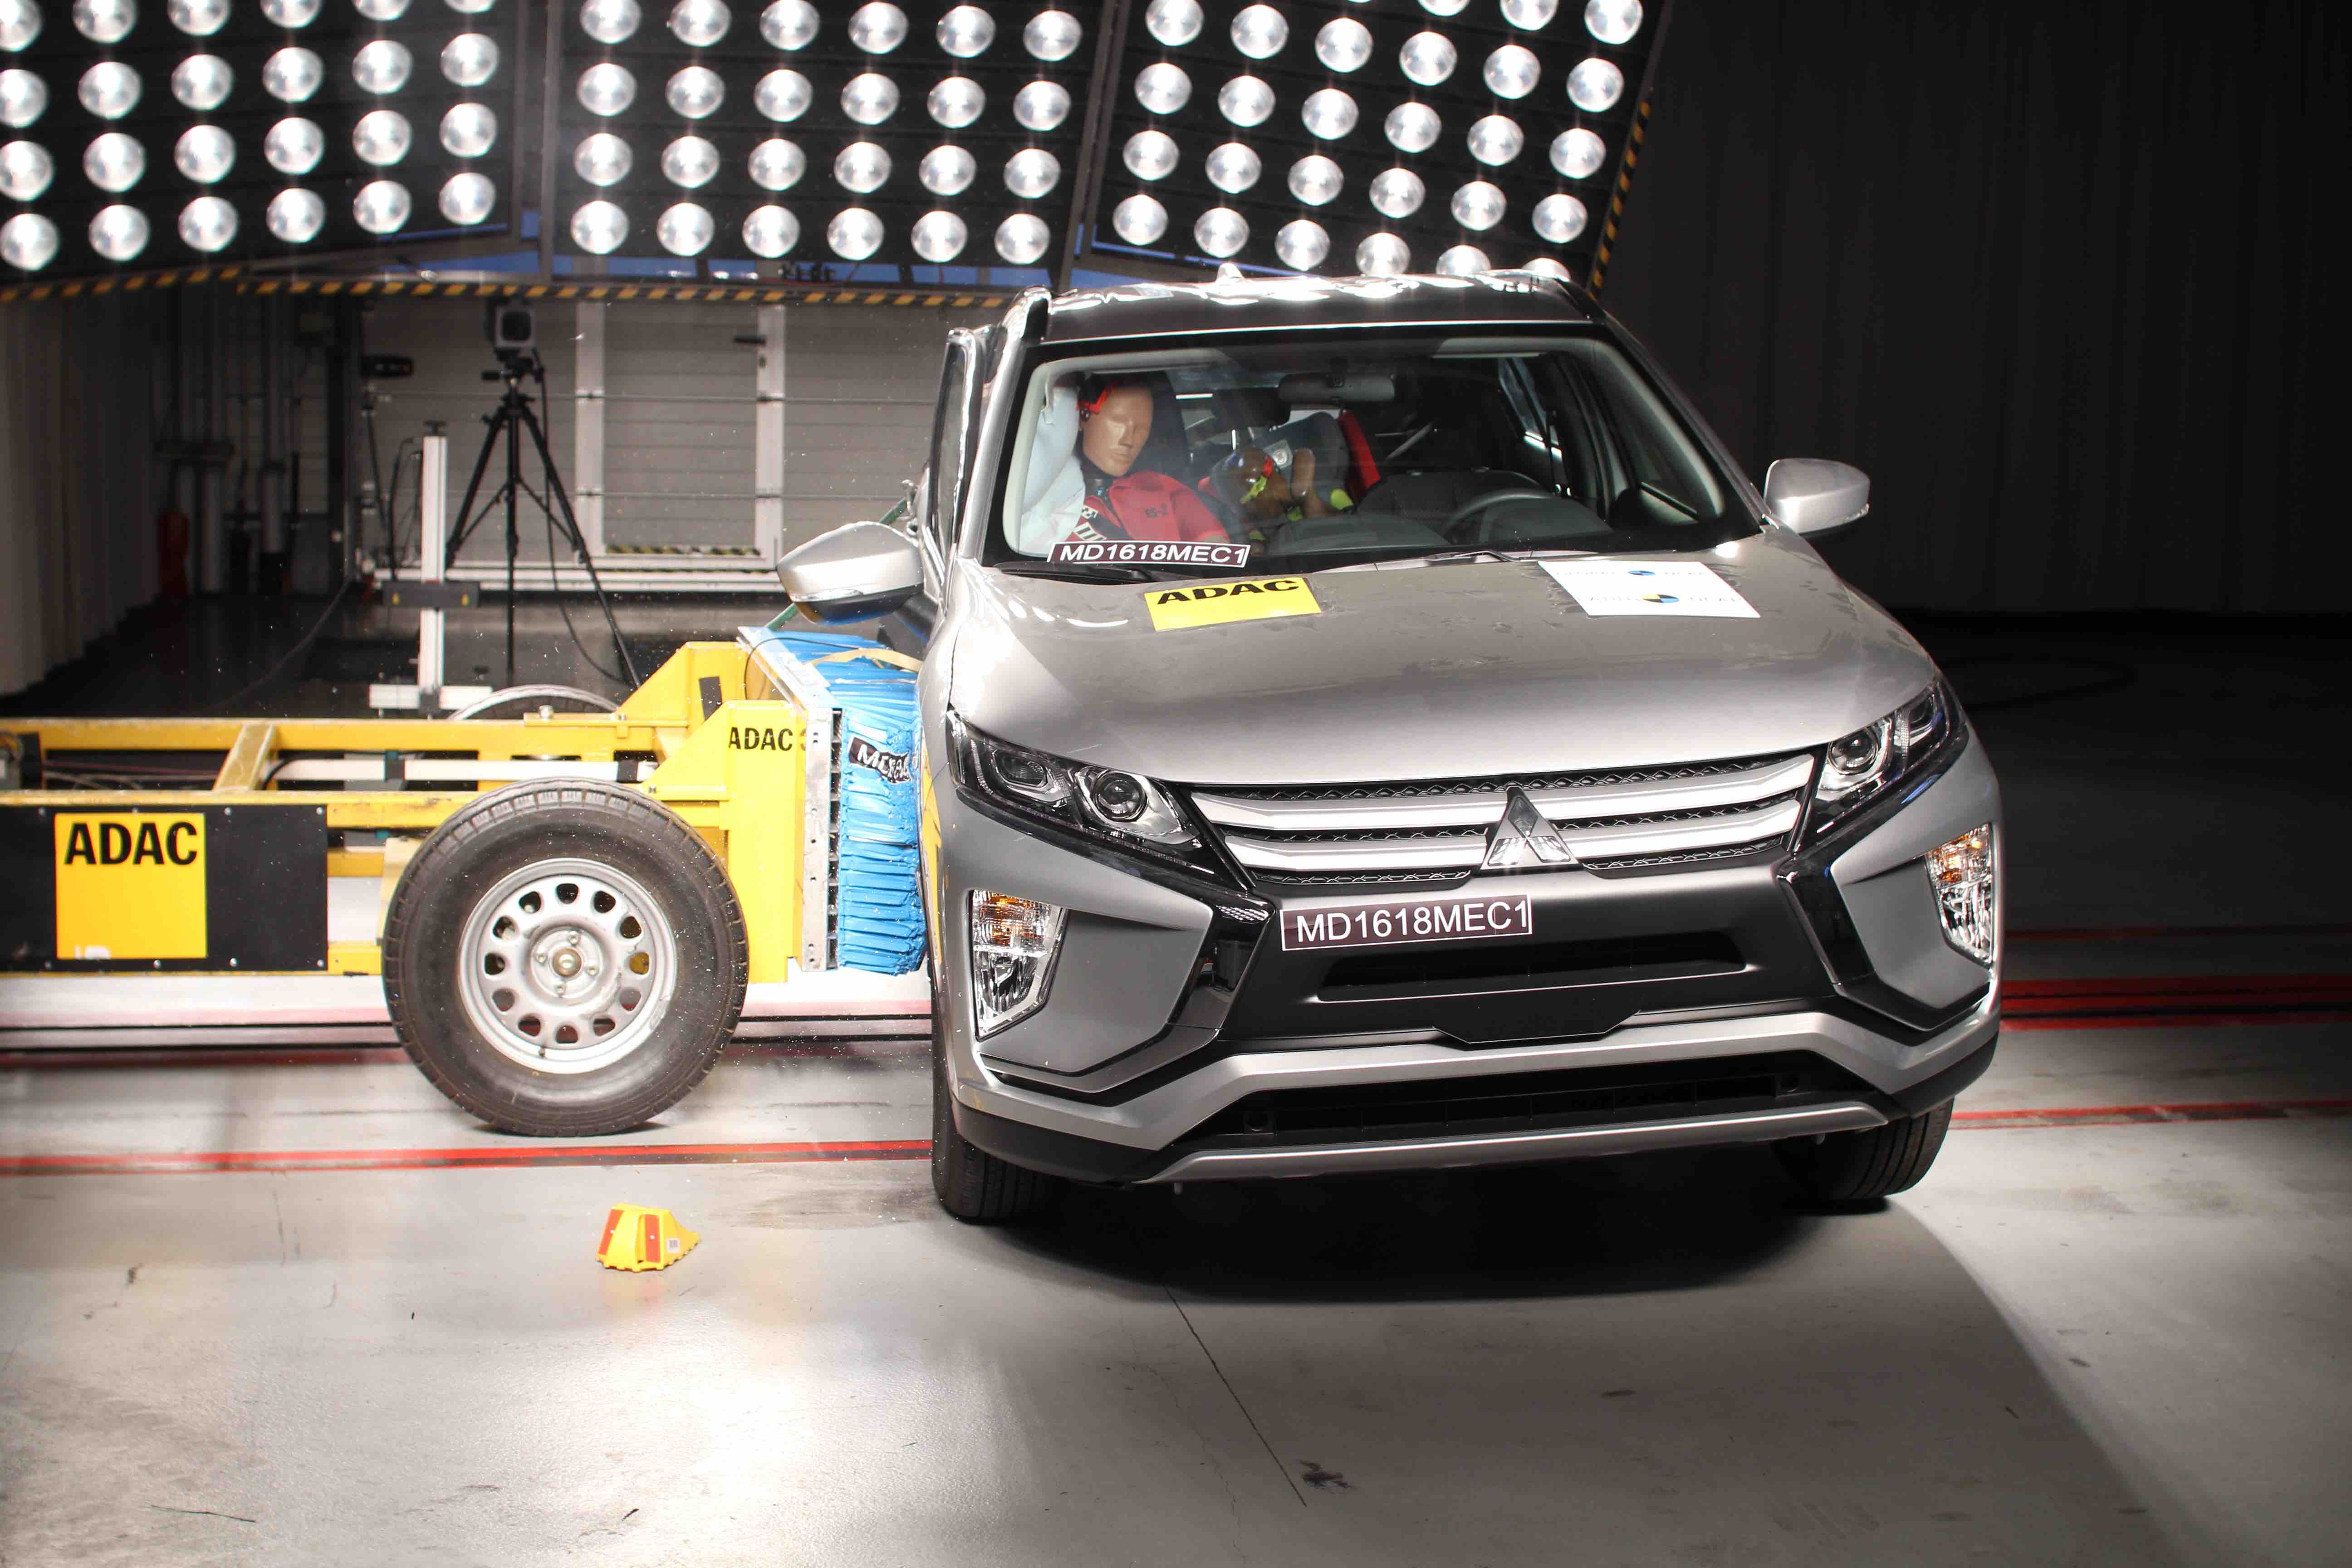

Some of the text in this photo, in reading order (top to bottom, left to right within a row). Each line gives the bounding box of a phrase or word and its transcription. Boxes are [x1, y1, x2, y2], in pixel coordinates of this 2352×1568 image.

[1060, 544, 1245, 564] MD1618MEC1
[1157, 580, 1299, 605] ADAC
[728, 727, 794, 751] ADAC
[64, 822, 197, 866] ADAC
[1296, 900, 1527, 942] MD1618MEC1
